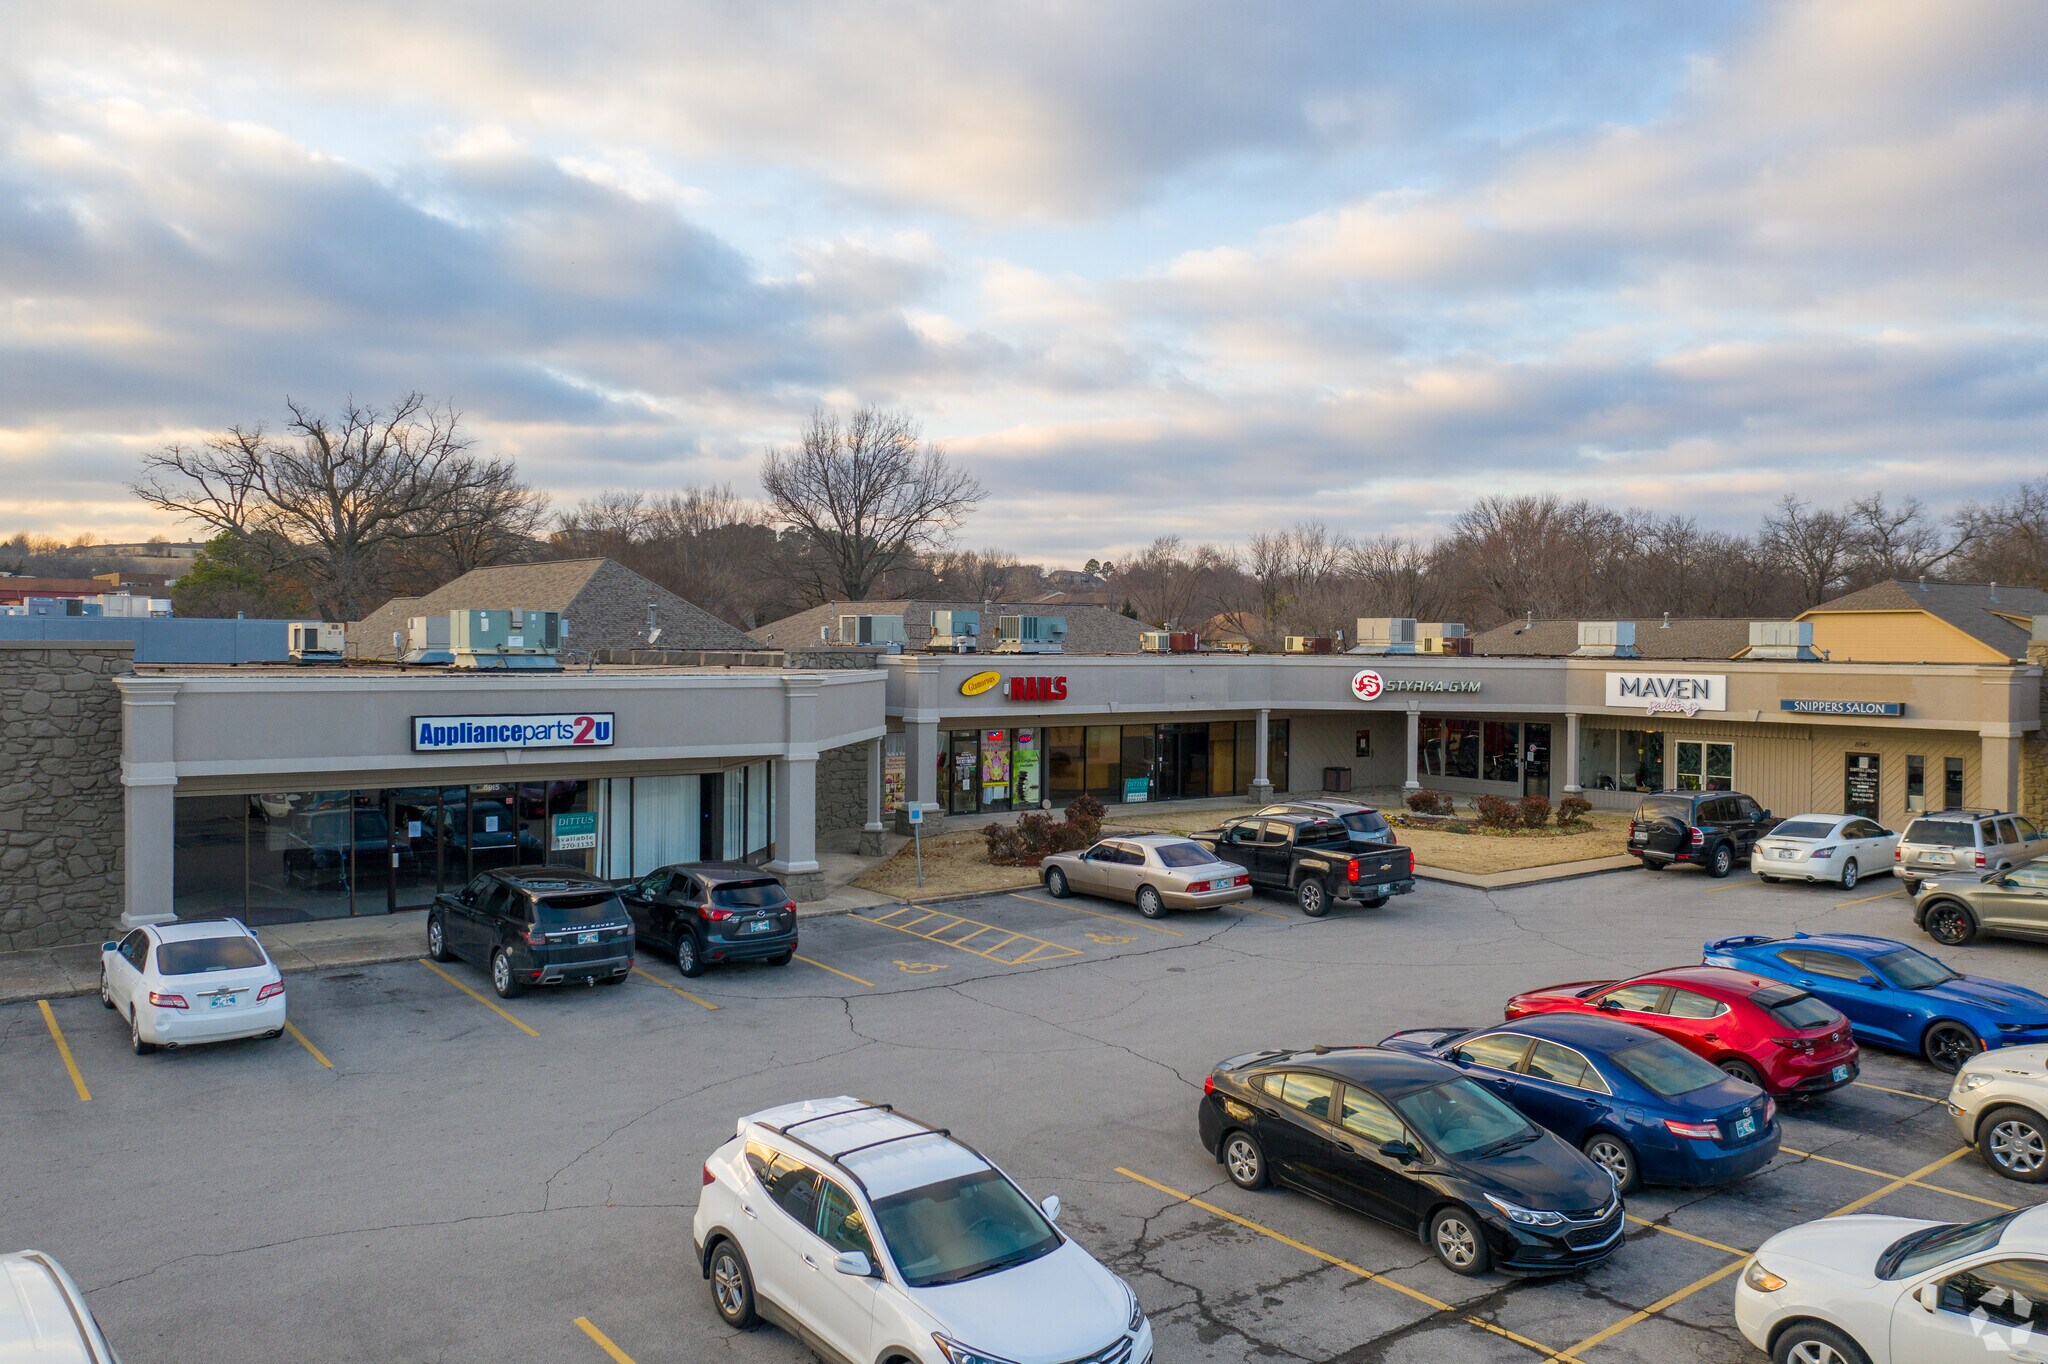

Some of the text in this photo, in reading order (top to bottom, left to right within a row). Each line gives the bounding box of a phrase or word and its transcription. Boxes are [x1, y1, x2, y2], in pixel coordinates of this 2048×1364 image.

[967, 675, 996, 692] Glamorous
[1010, 676, 1067, 702] NAILS
[1385, 680, 1481, 692] STYRKA GYM
[1619, 676, 1709, 700] MAVEN
[1647, 691, 1698, 716] salons
[1794, 701, 1885, 714] SNIPPERS SALON
[559, 816, 594, 826] DITTUS
[555, 835, 594, 843] Available
